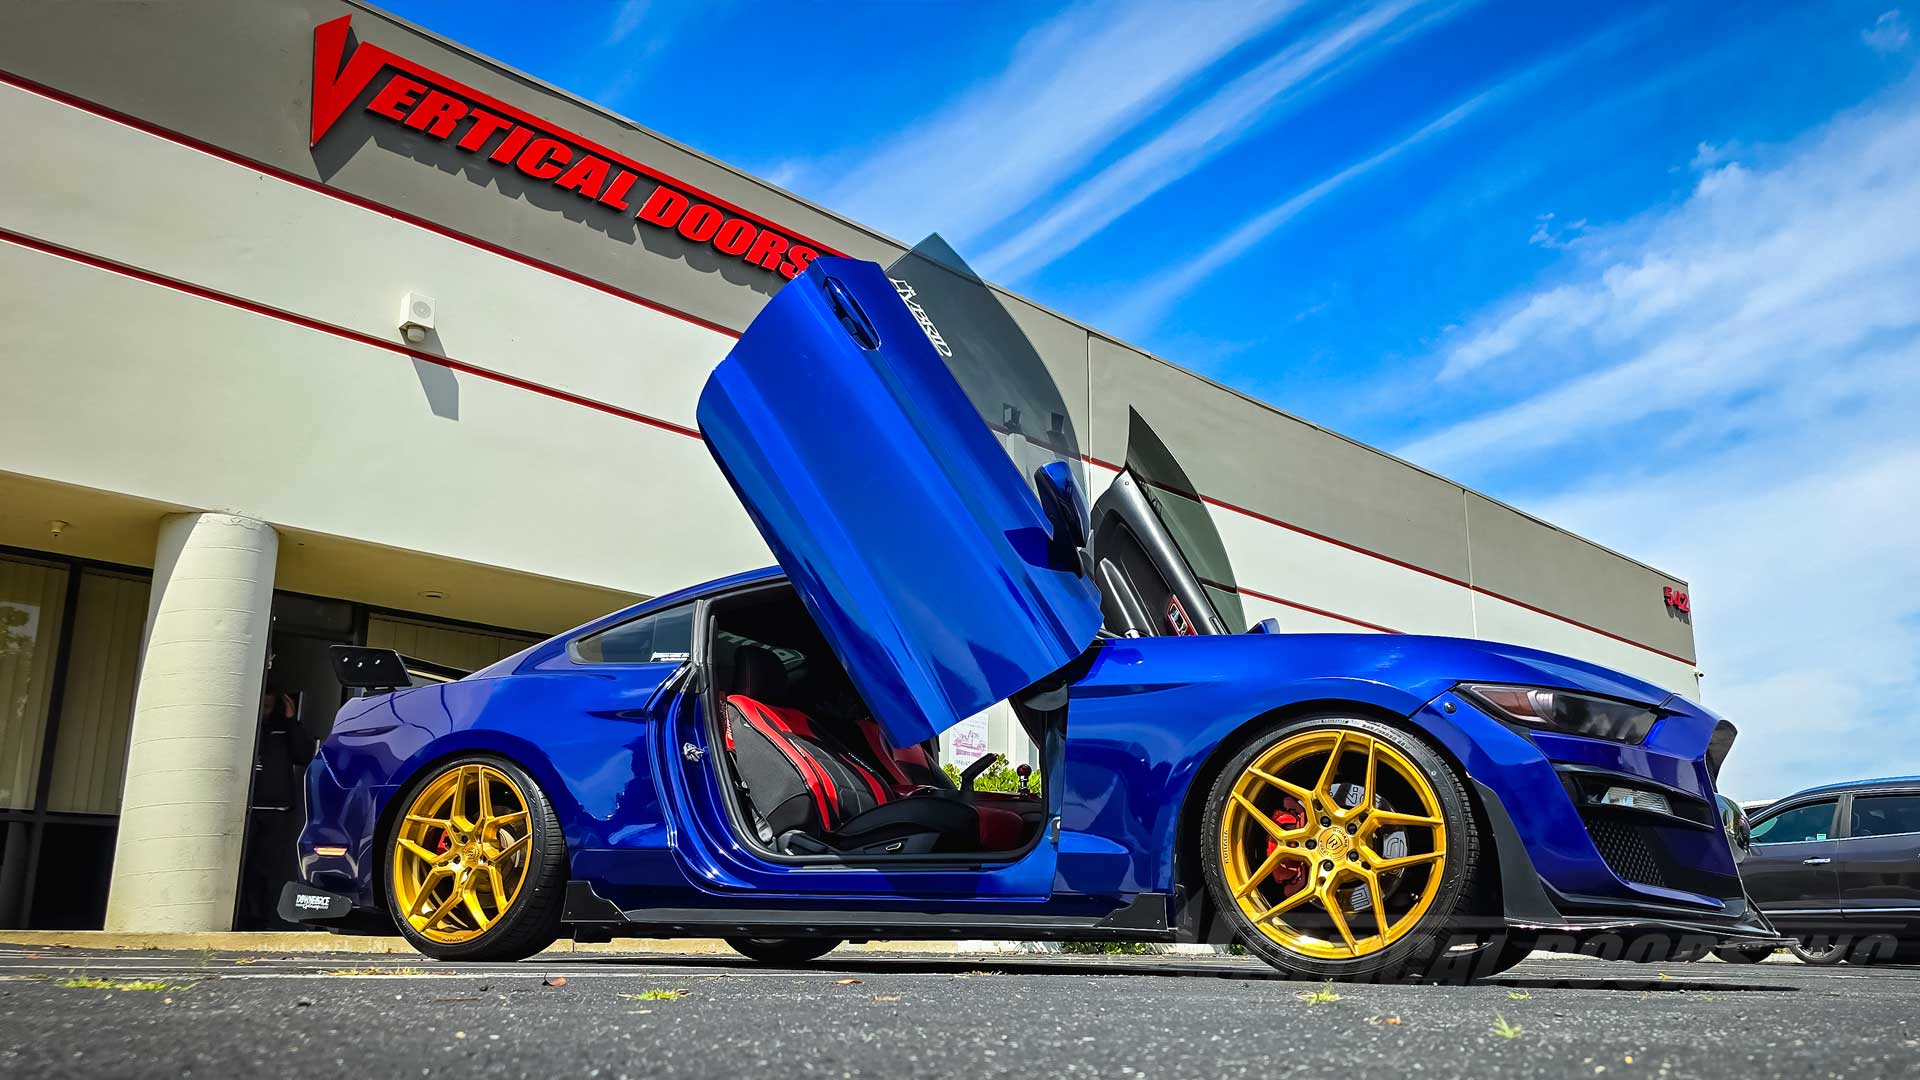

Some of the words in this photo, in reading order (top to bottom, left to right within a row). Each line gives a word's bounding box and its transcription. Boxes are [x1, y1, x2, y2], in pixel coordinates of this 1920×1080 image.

[311, 14, 638, 212] VERTICAL
[635, 185, 820, 280] DOORS
[1663, 586, 1690, 612] 542
